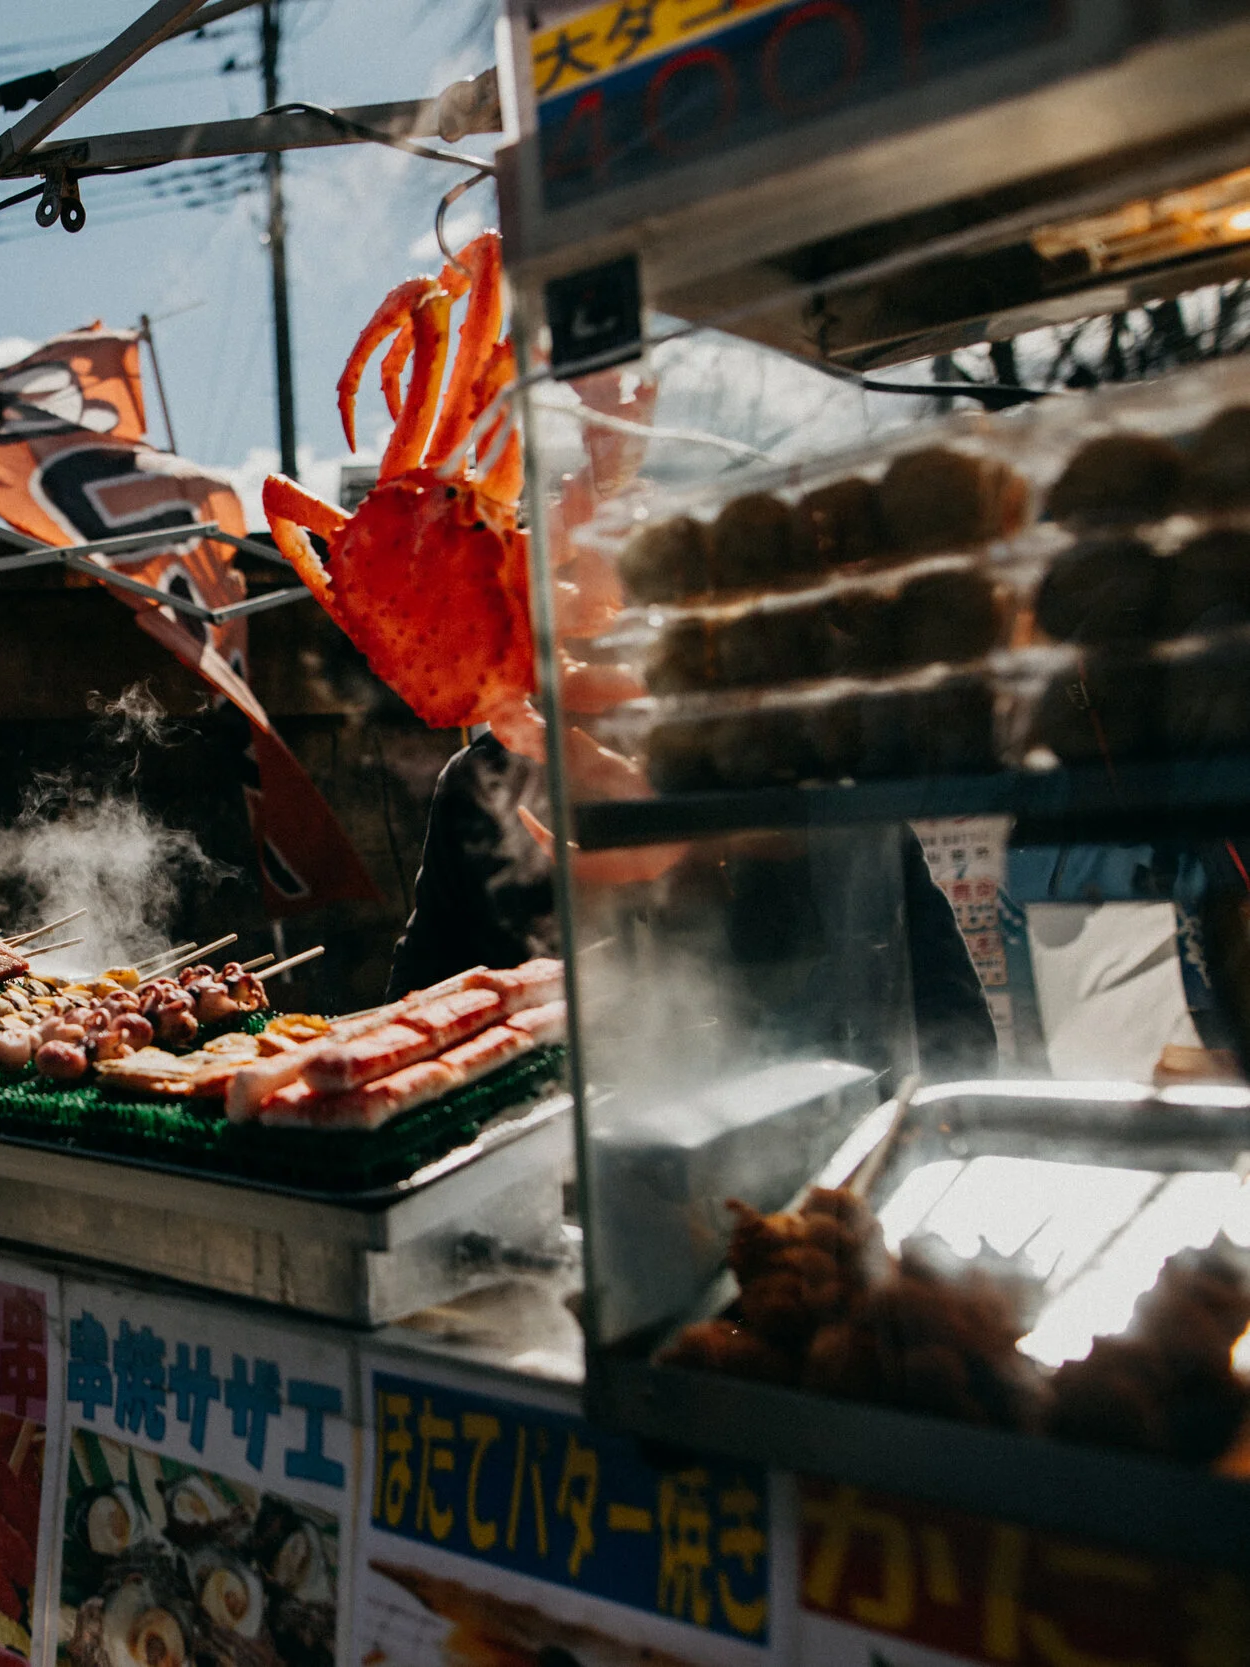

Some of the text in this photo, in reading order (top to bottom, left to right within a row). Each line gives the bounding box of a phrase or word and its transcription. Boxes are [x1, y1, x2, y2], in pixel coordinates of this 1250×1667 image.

[68, 1310, 345, 1488] 串焼サザエ
[372, 1389, 768, 1636] ほたてバター焼き
